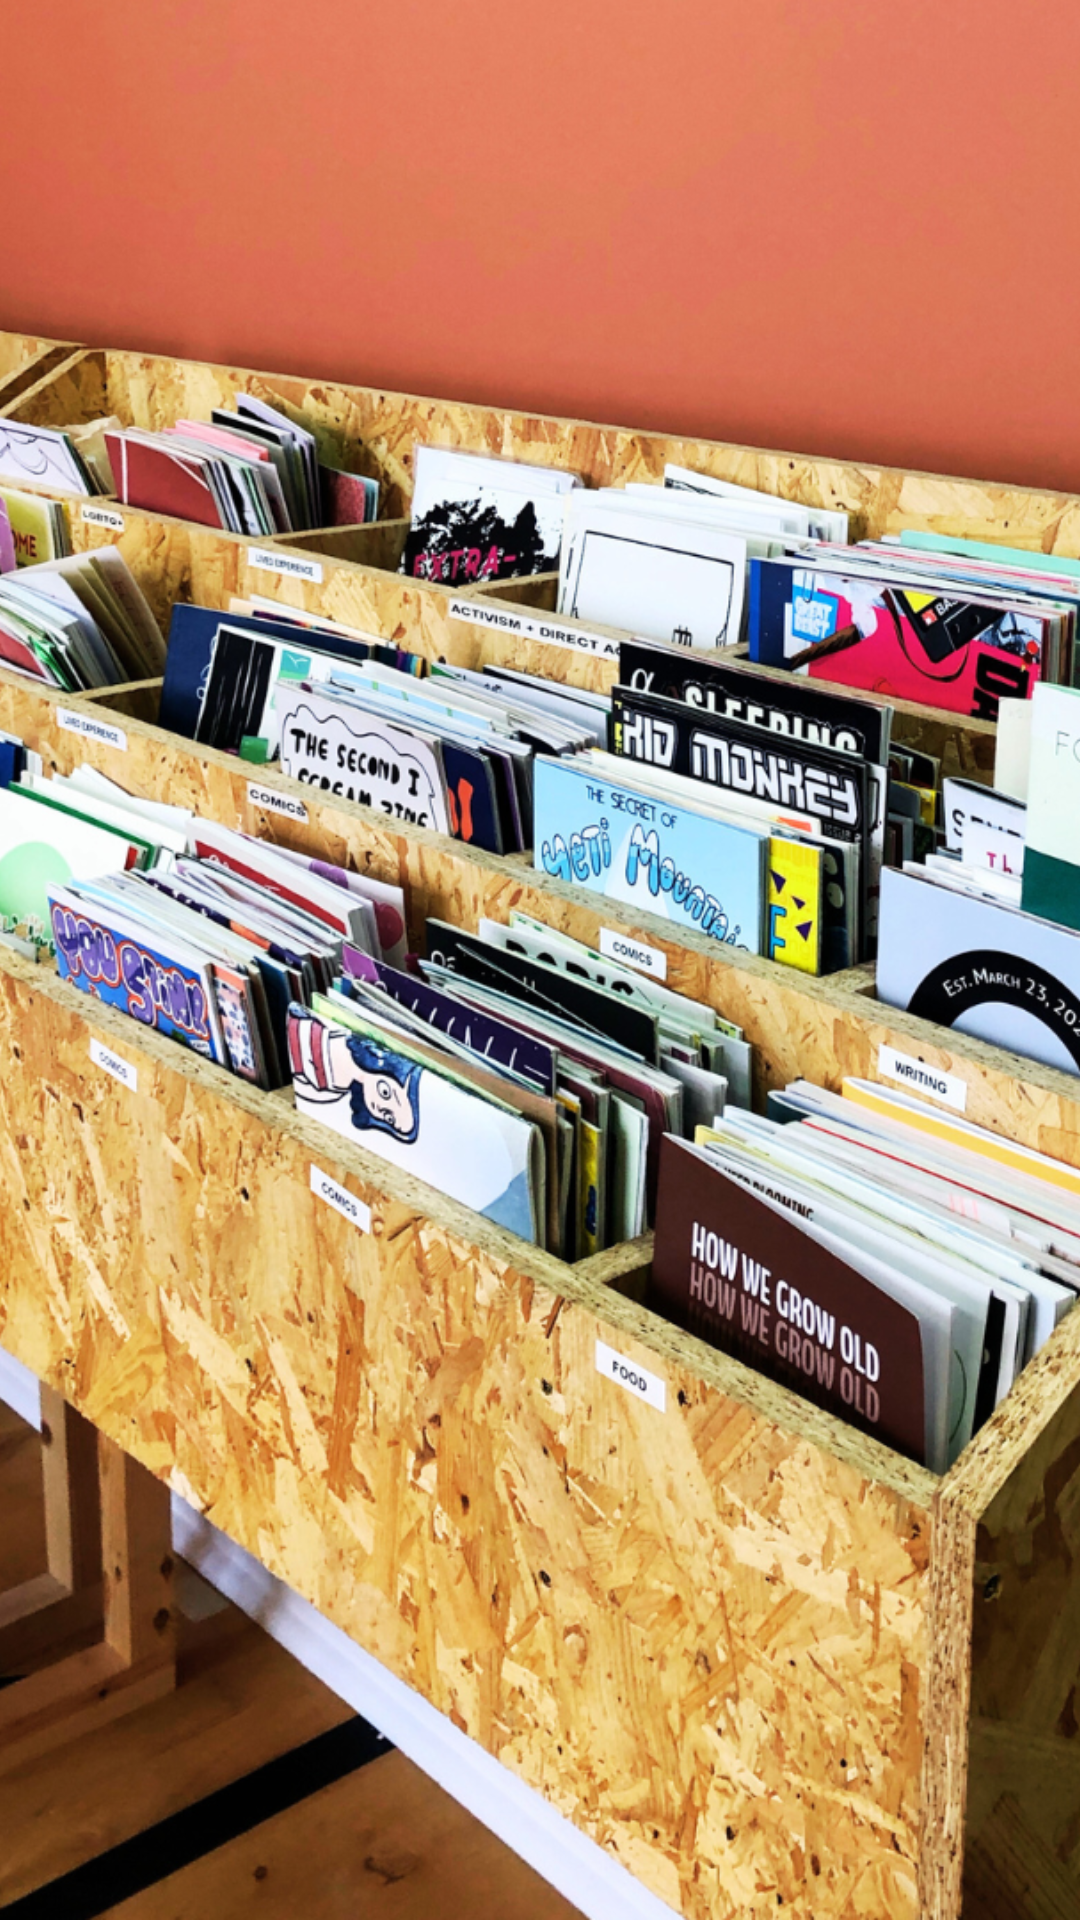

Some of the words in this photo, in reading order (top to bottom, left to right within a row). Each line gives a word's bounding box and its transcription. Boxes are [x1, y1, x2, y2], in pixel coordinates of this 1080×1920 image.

[83, 510, 123, 526] LGBTQ+
[275, 558, 314, 577] EXPERIENCE
[451, 603, 522, 631] ACTIVISM
[526, 623, 535, 633] +
[540, 626, 599, 650] DIRECT
[290, 728, 329, 761] THE
[337, 744, 401, 785] SECOND
[408, 768, 420, 797] I
[622, 708, 678, 768] KID
[691, 730, 859, 827] MONKEY
[250, 789, 306, 817] COMICS
[586, 785, 605, 805] THE
[611, 791, 657, 822] SECRET
[661, 811, 678, 829] OF
[52, 902, 120, 988] YOU
[613, 941, 653, 967] COMICS
[99, 1052, 128, 1079] COMICS
[895, 1060, 948, 1095] WRITING
[321, 1182, 358, 1217] COMICS
[692, 1221, 739, 1281] HOW
[742, 1253, 771, 1306] WE
[776, 1279, 836, 1350] GROW
[840, 1325, 881, 1383] OLD
[689, 1261, 737, 1321] HOW
[740, 1293, 771, 1346] WE
[774, 1320, 836, 1391] GROW
[839, 1366, 881, 1424] OLD
[612, 1360, 648, 1392] FOOD
